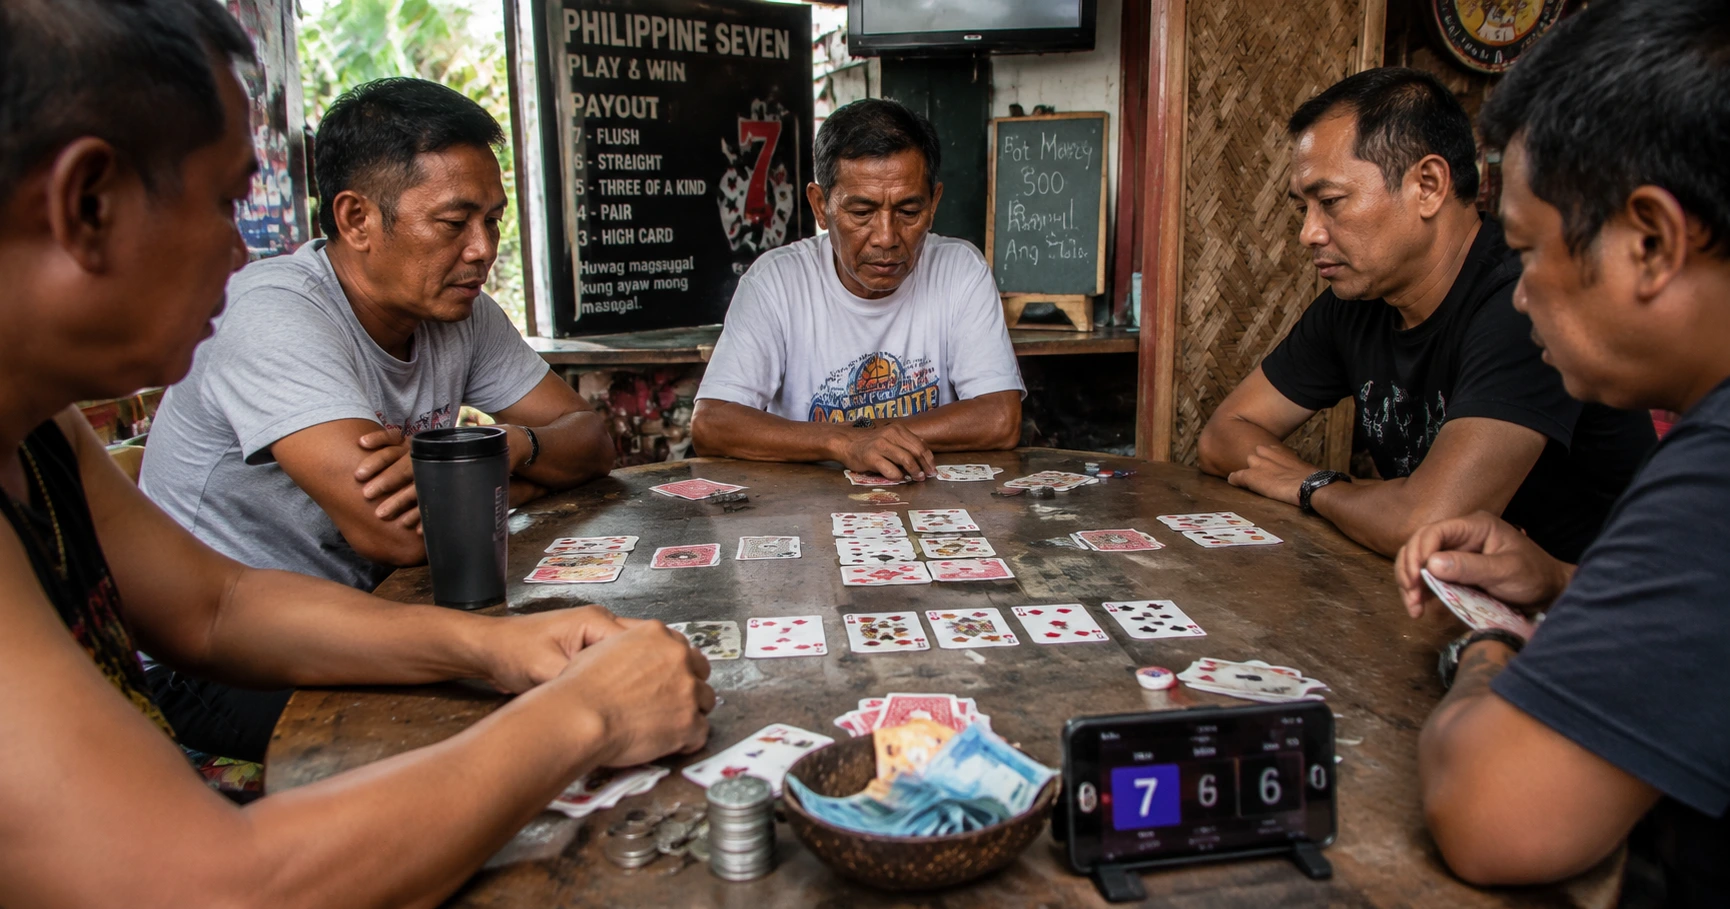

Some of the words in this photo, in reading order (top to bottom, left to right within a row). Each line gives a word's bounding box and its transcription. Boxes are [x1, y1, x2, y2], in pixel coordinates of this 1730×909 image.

[562, 8, 708, 53] PHILIPPINE
[715, 22, 789, 60] SEVEN
[568, 54, 620, 79] PLAY
[628, 58, 641, 80] &
[646, 59, 687, 82] WIN
[570, 92, 659, 120] PAYOUT
[573, 126, 581, 144] 7
[597, 128, 640, 145] FLUSH
[575, 153, 584, 170] 6
[575, 178, 585, 196] 5
[598, 179, 642, 196] THREE
[645, 179, 661, 196] OF
[664, 179, 674, 196] A
[676, 179, 707, 196] KIND
[577, 204, 587, 221] 4
[601, 204, 632, 221] PAIR
[578, 230, 588, 247] 3
[602, 228, 635, 246] HIGH
[638, 227, 674, 244] CARD
[1004, 239, 1039, 265] Ang
[580, 260, 625, 276] Huwag
[581, 280, 613, 297] kung
[617, 280, 650, 296] ayaw
[654, 277, 689, 292] mong
[1134, 777, 1158, 817] 7
[1198, 773, 1218, 806] 6
[1260, 767, 1281, 805] 6
